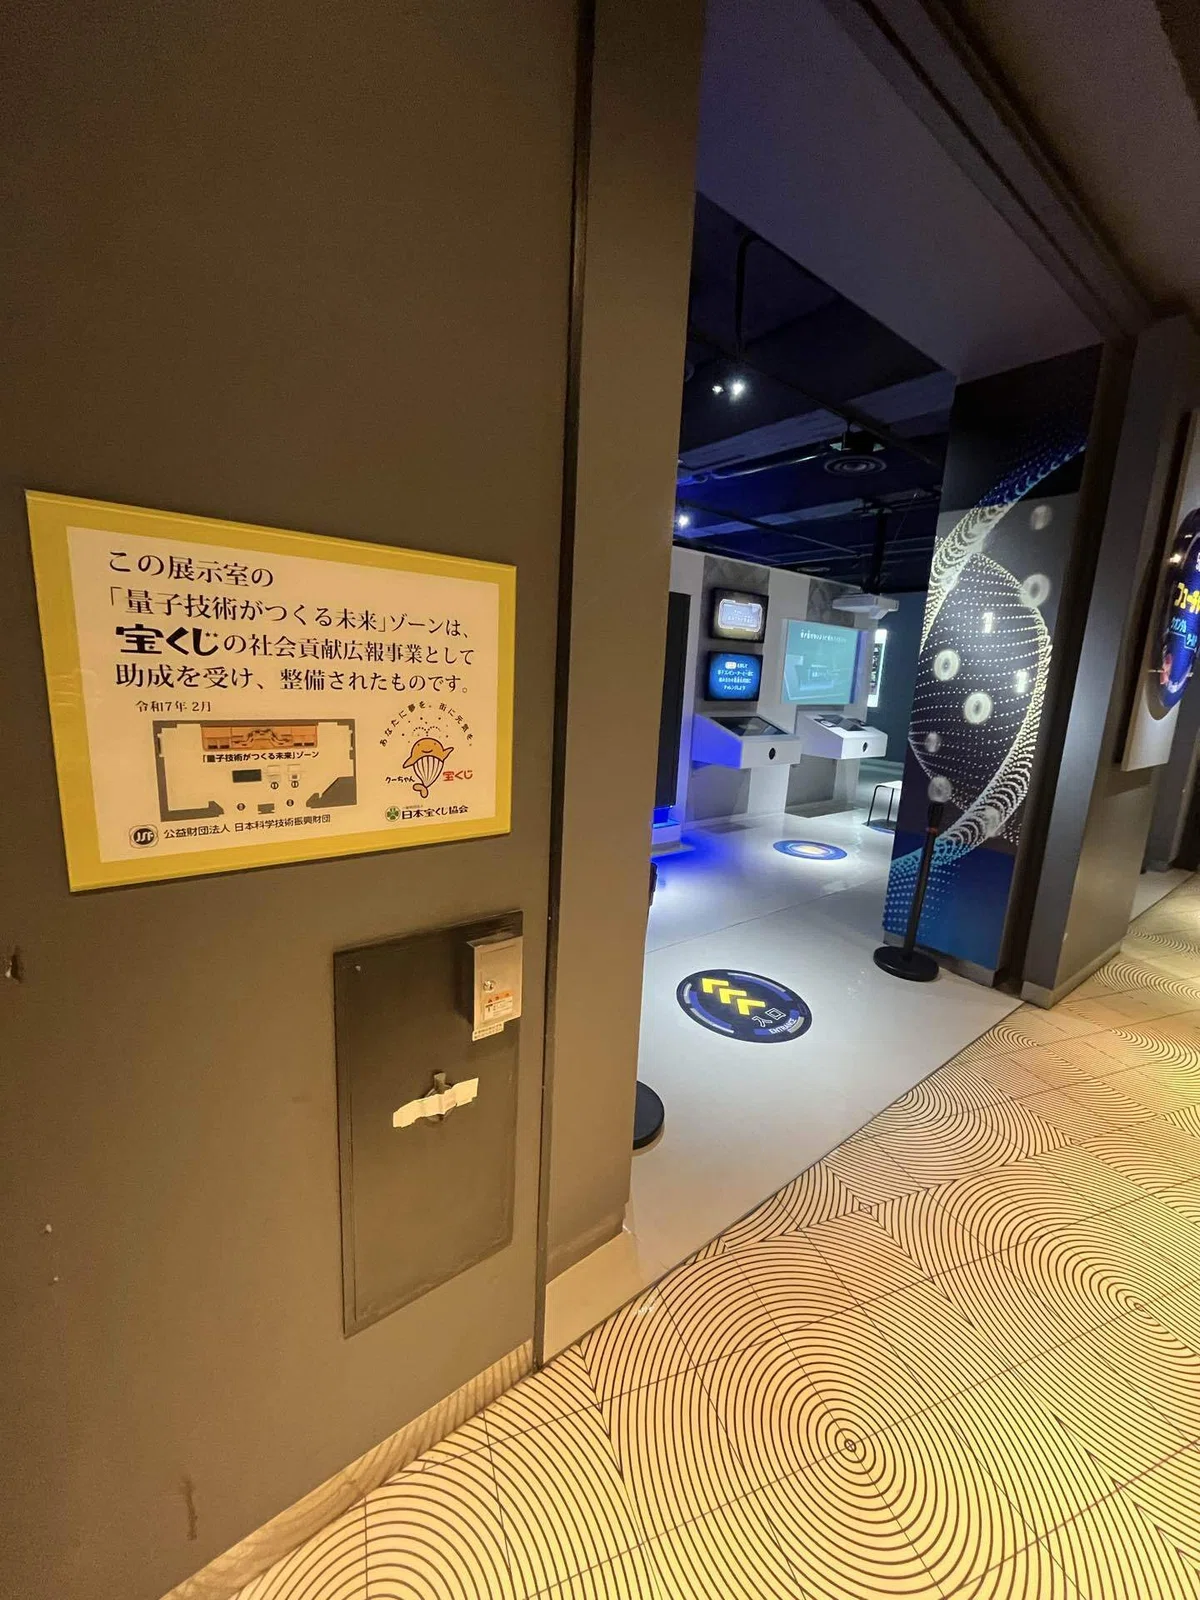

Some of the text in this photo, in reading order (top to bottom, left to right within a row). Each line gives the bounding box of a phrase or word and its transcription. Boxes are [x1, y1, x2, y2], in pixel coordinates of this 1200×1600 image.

[109, 551, 274, 588] この展示室の
[109, 586, 469, 639] 「量子技術がつくる未来」ゾーンは、
[115, 623, 475, 666] 宝くじの社会貢献広報事業として
[442, 769, 474, 782] 宝くじ
[163, 823, 231, 839] 公益財団法人
[752, 1007, 786, 1028] 入口
[768, 1018, 798, 1035] ENTRANCE
